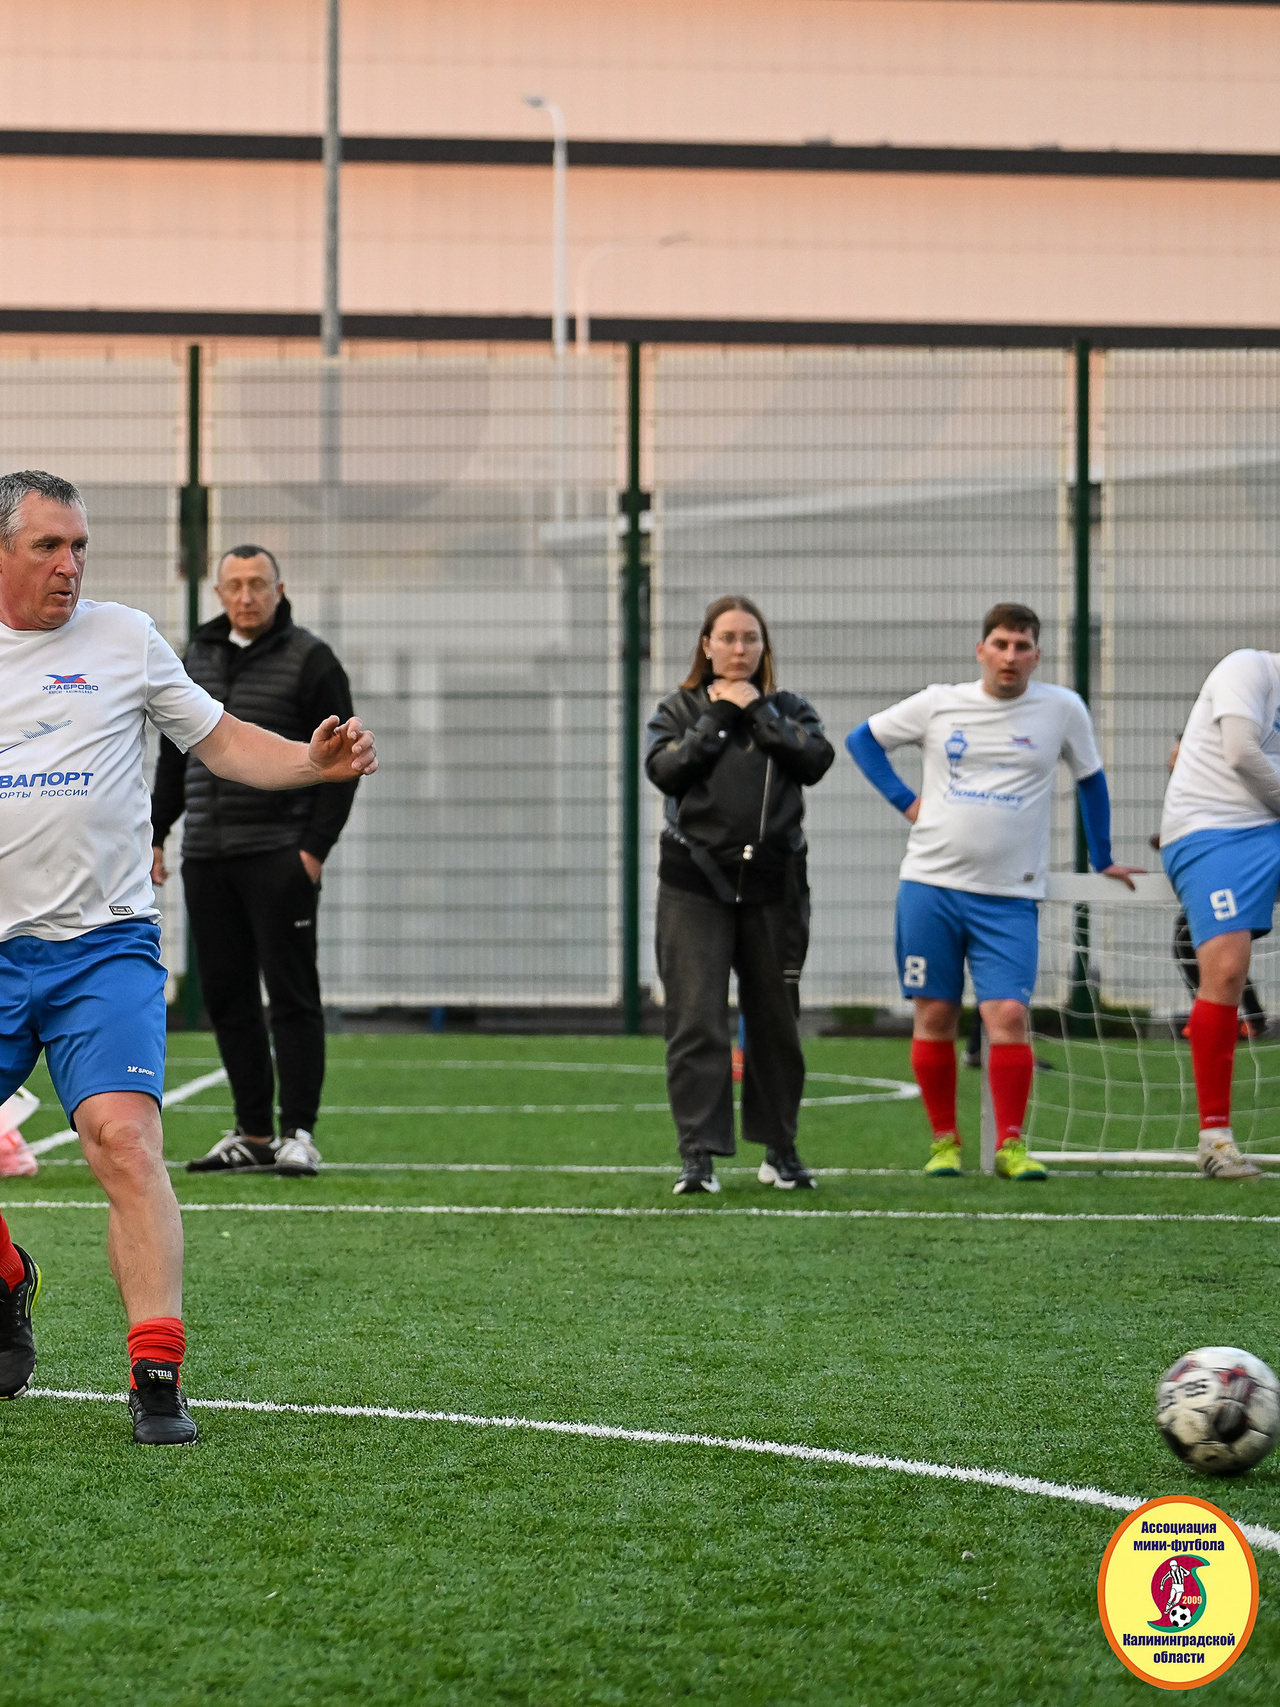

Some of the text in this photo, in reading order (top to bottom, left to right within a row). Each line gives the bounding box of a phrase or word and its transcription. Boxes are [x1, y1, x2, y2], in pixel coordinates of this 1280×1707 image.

[40, 789, 89, 798] РОССИИ
[1210, 888, 1238, 921] 9
[904, 955, 927, 988] 8
